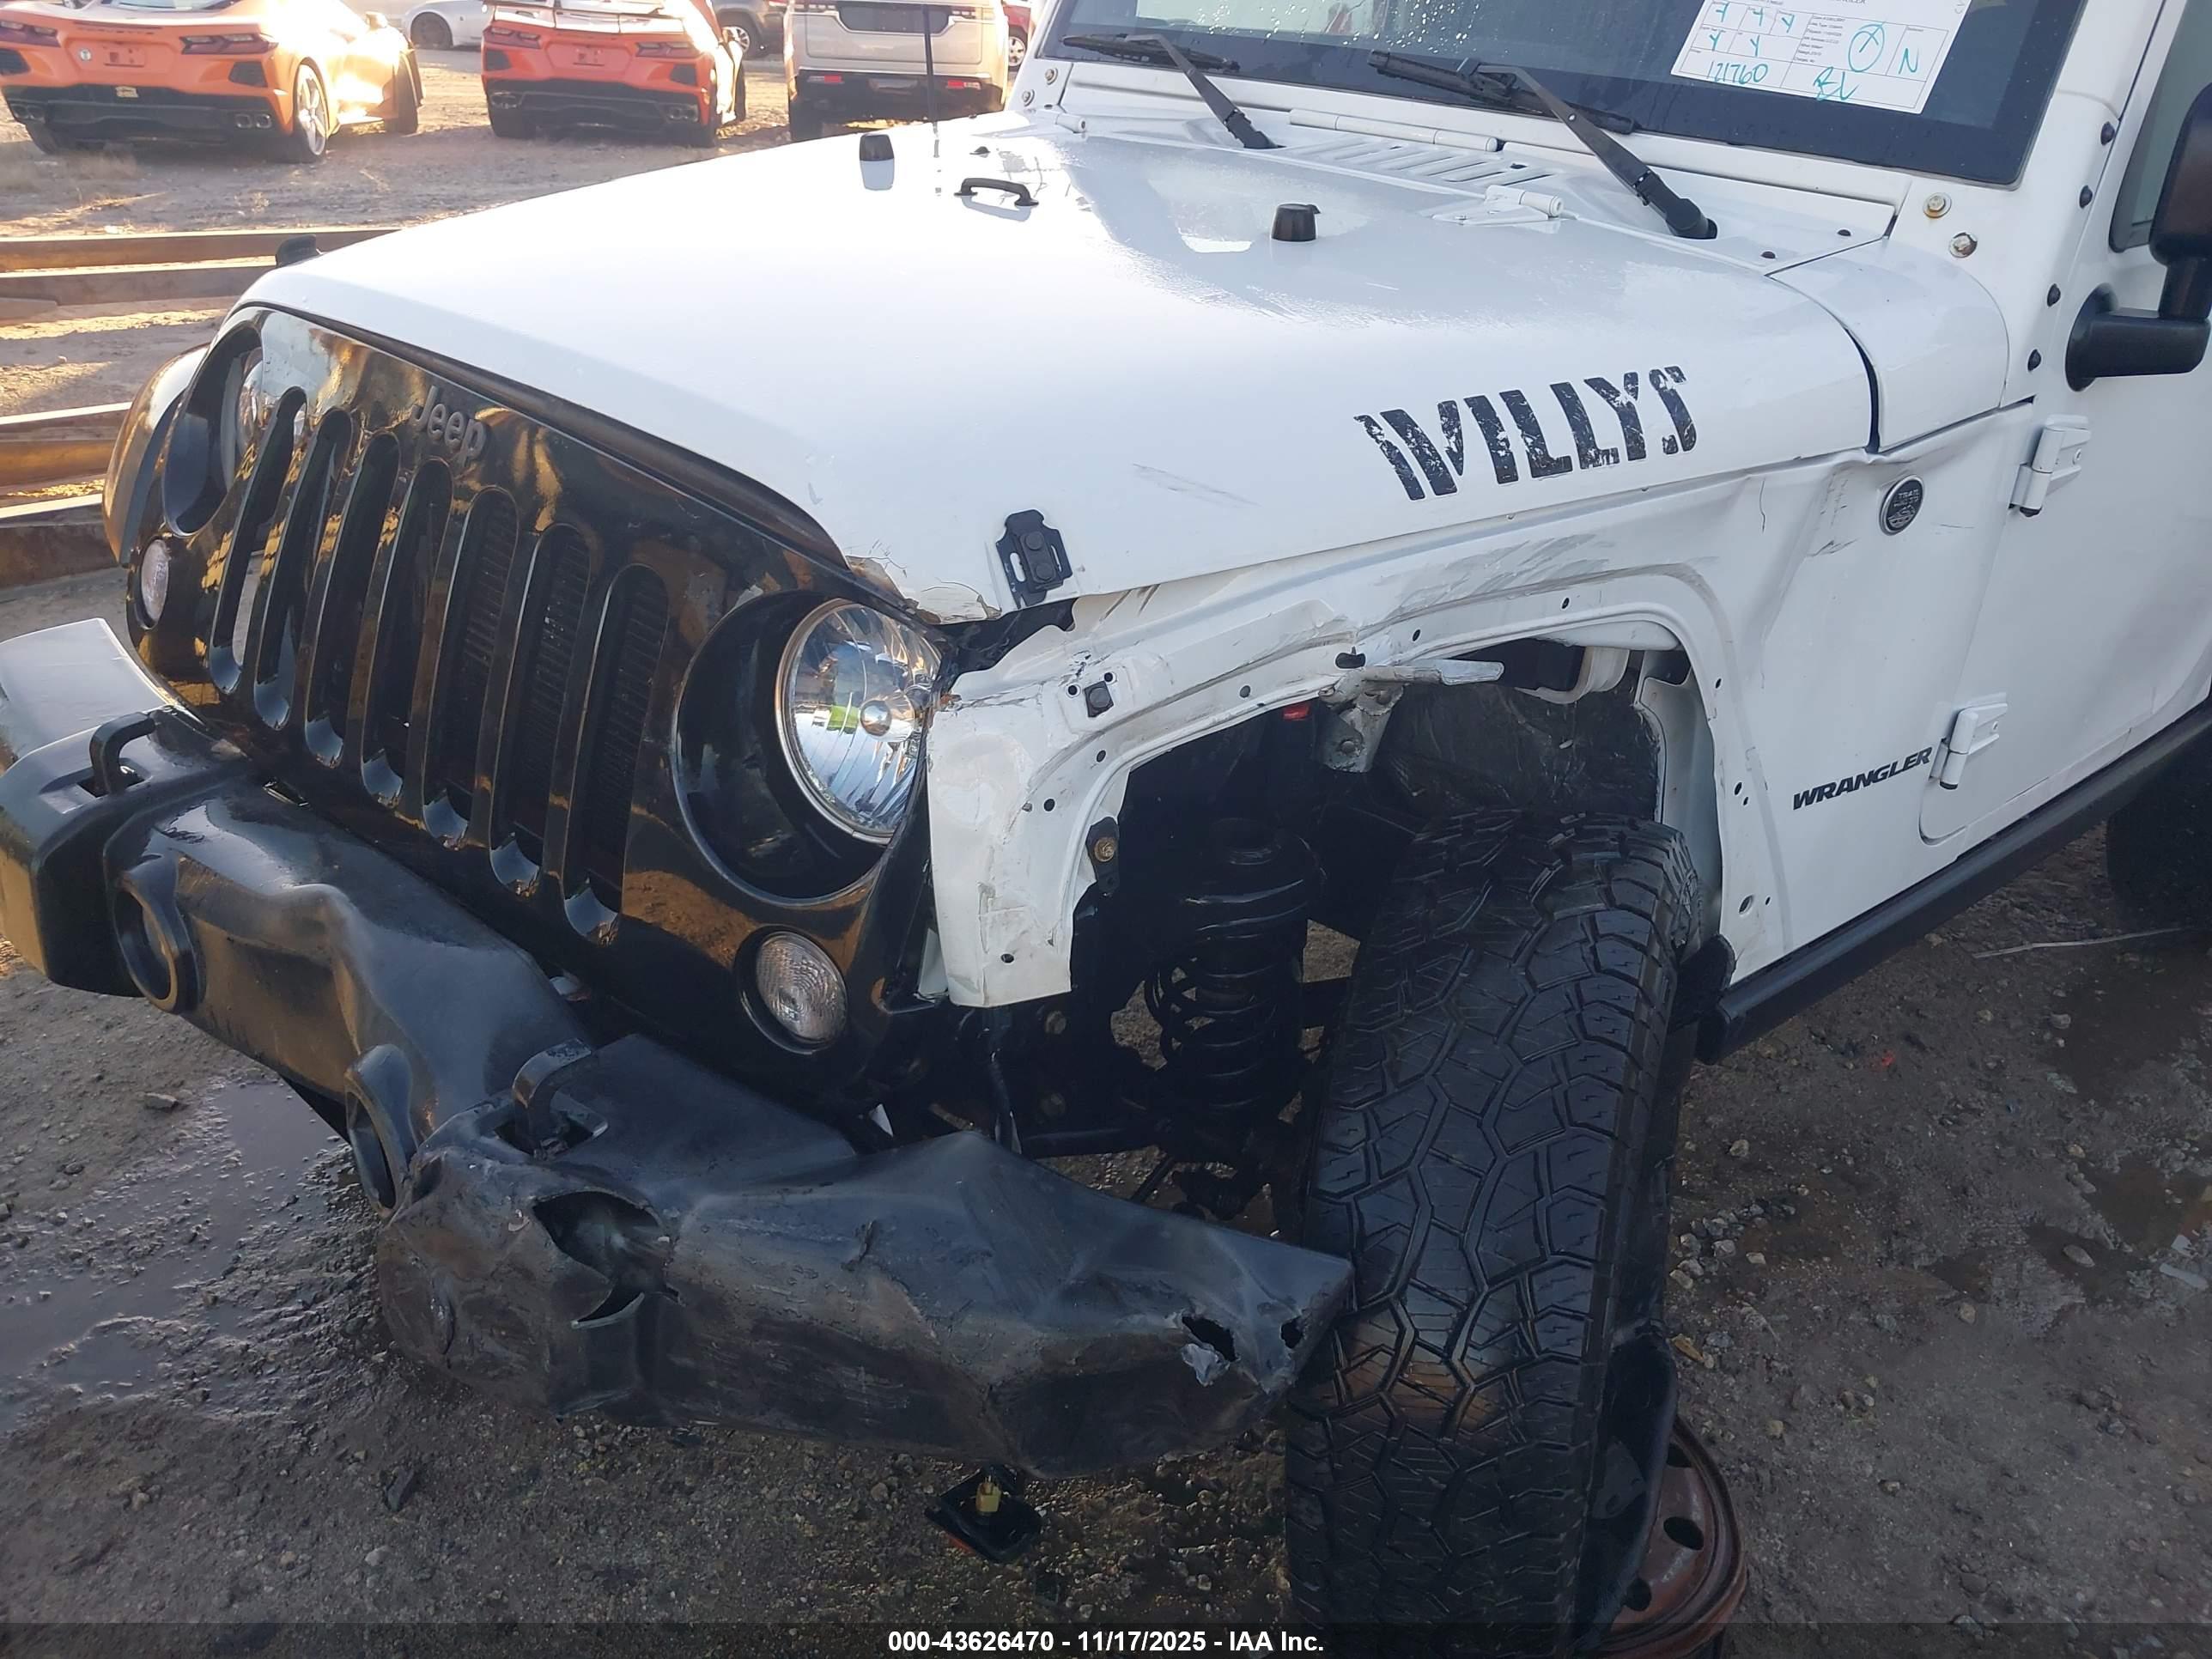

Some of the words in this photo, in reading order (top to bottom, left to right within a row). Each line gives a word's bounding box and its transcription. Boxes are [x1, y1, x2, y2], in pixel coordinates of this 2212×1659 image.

[410, 385, 487, 465] Jeep
[1353, 366, 1697, 501] WILLYS
[1793, 746, 1932, 811] WRANGLER
